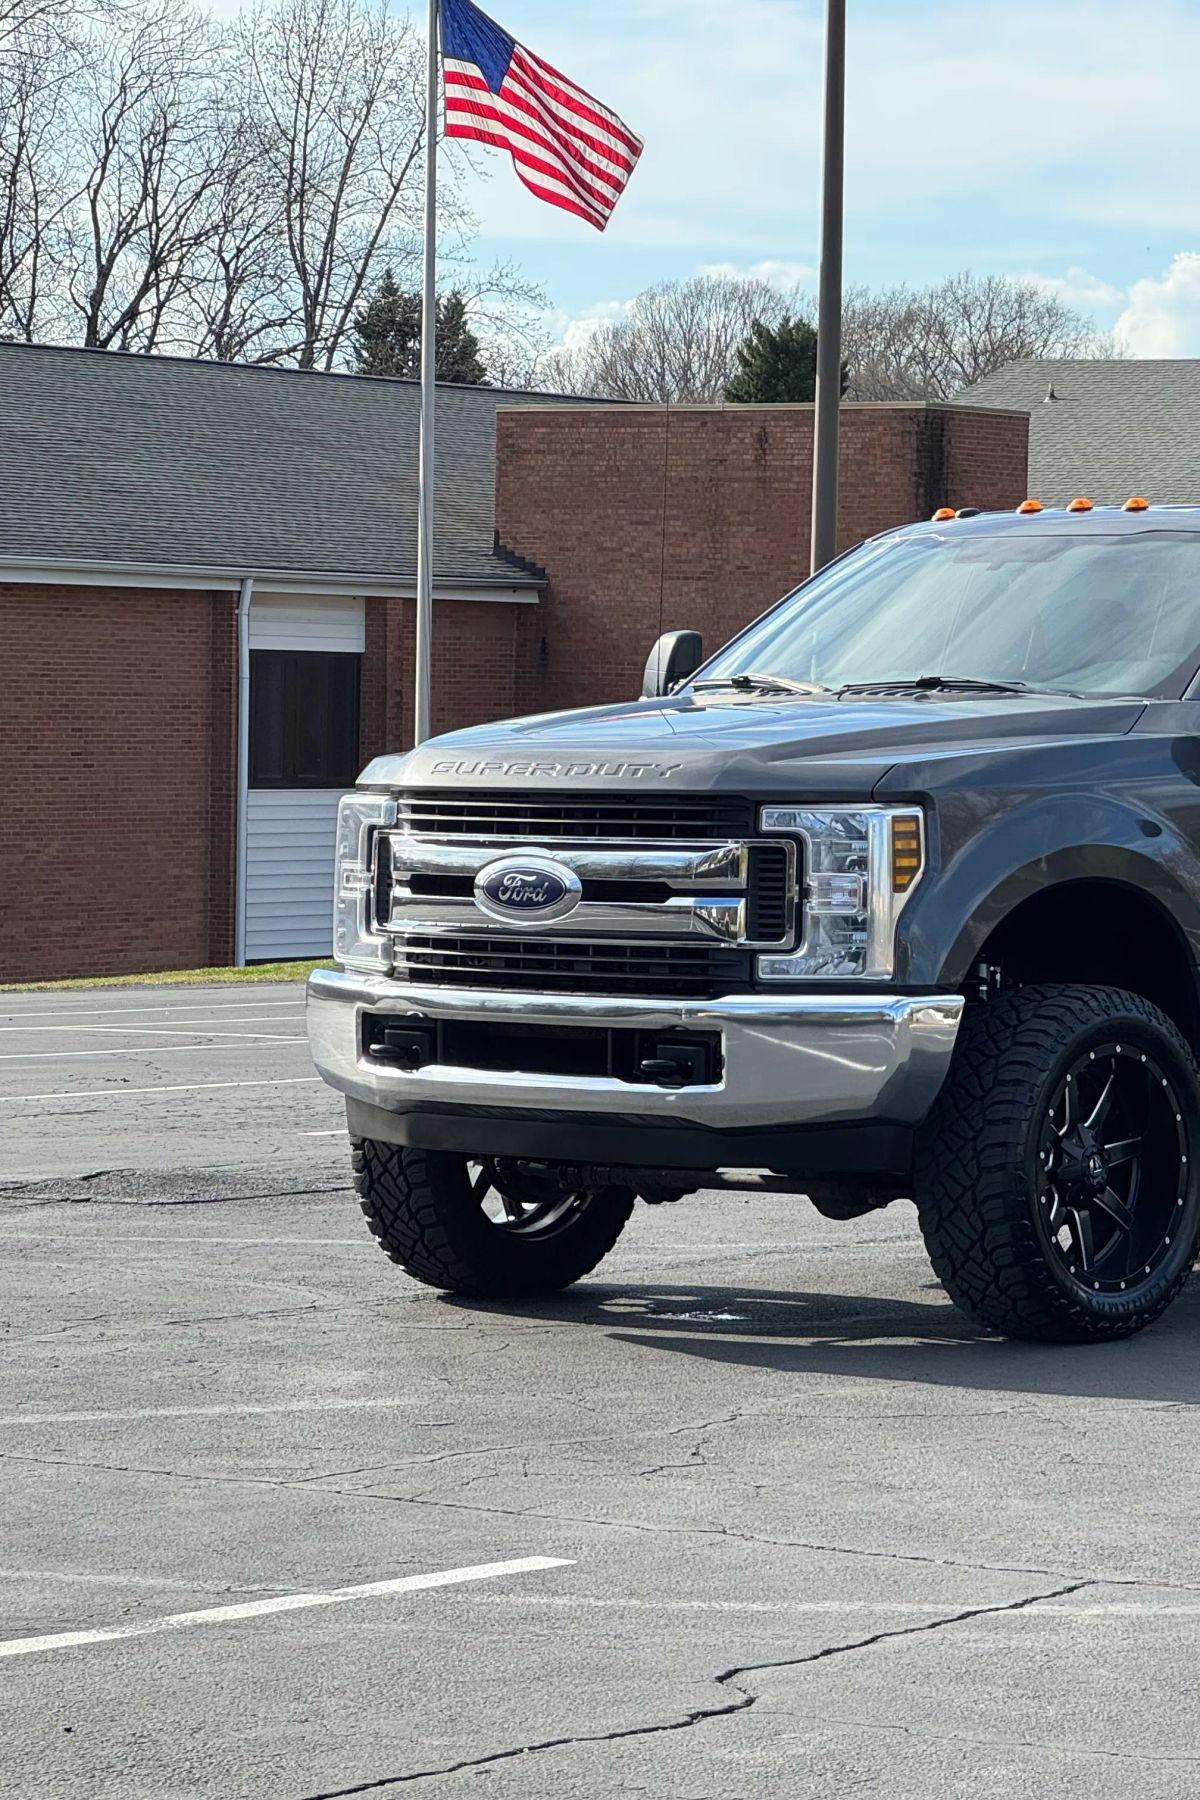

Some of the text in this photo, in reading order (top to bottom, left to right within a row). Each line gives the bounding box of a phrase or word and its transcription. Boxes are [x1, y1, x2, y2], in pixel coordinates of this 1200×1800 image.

[430, 761, 684, 778] SUPER DUTY
[498, 873, 548, 902] Ford
